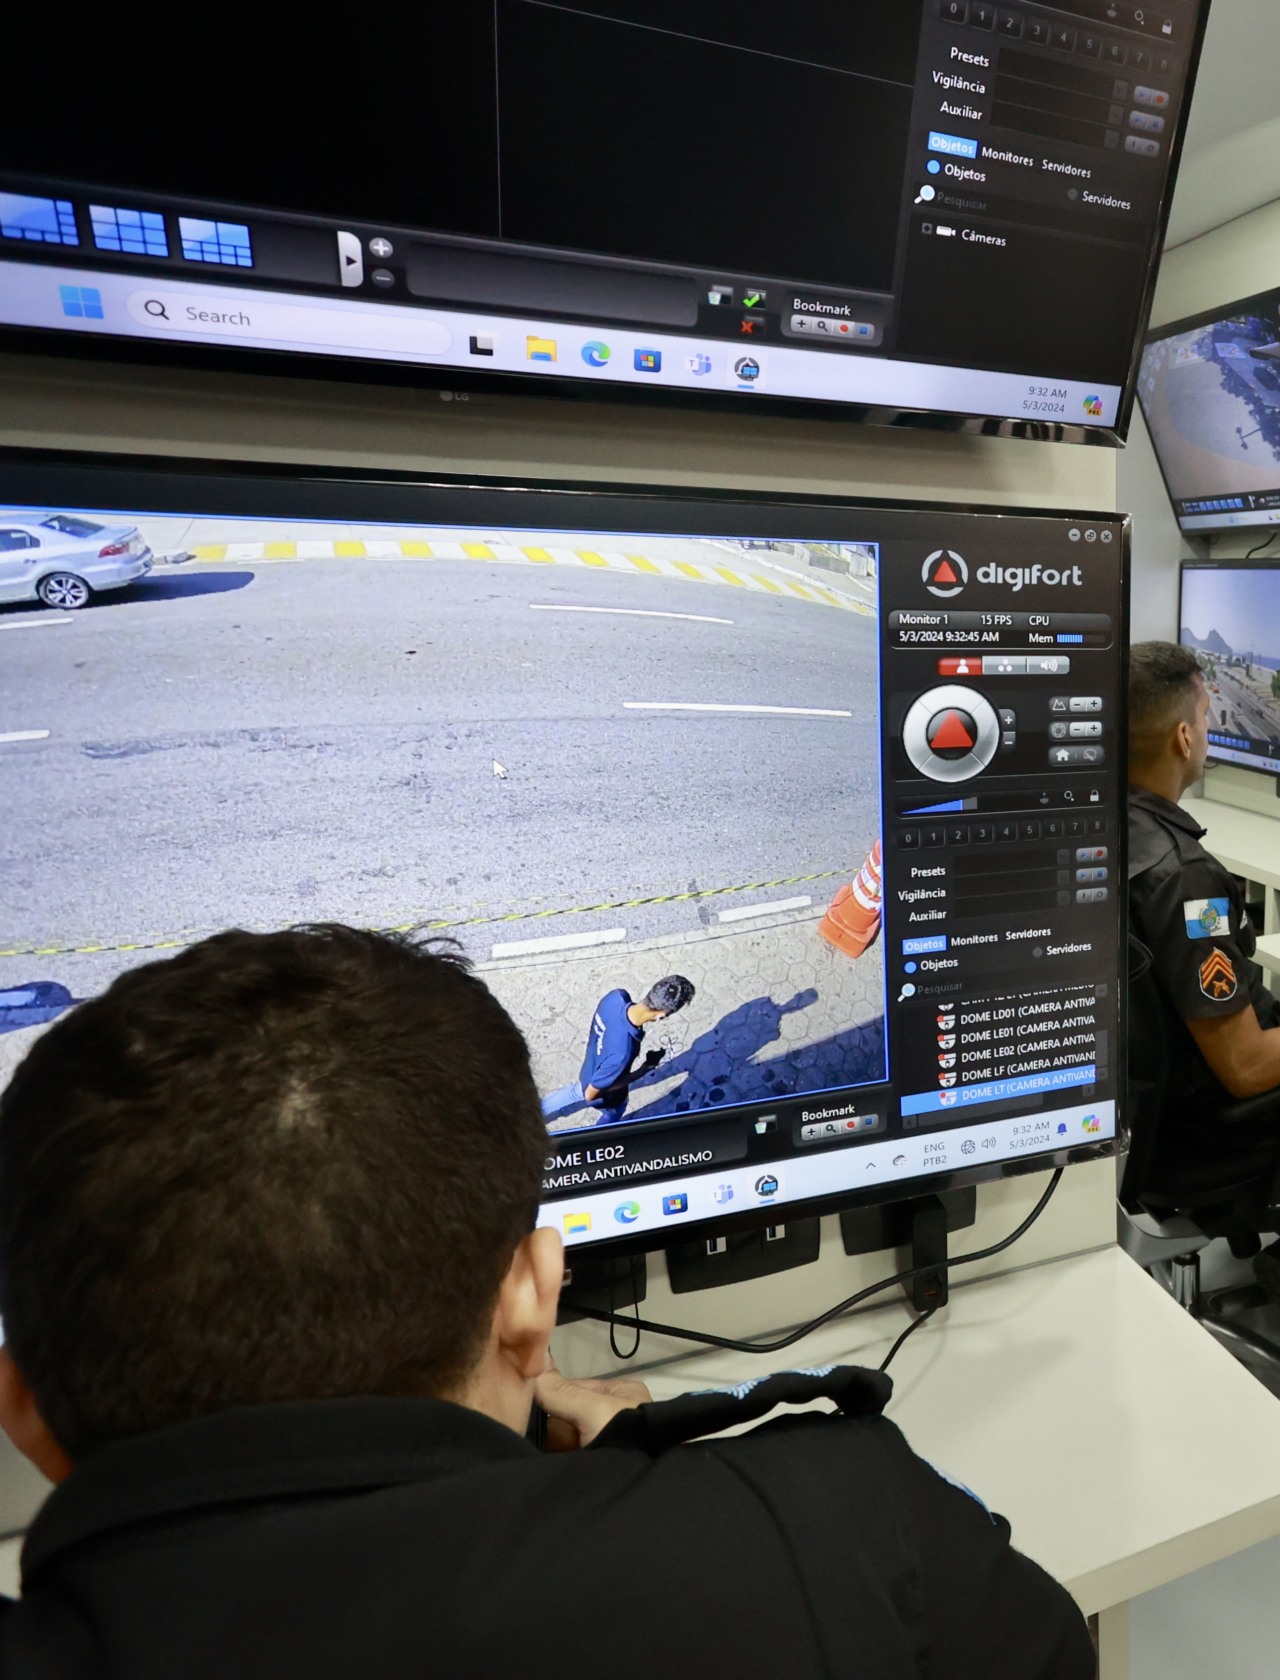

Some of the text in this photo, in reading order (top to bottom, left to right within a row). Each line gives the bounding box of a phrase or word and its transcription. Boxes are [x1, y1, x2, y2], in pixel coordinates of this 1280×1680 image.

[950, 47, 990, 68] Presets
[932, 71, 986, 94] Vigilância
[940, 101, 983, 121] Auxiliar
[931, 136, 1091, 179] Objetos Monitores Servidores
[944, 164, 986, 183] Objetos
[1082, 191, 1131, 210] Servidores
[962, 229, 1006, 247] Câmeras
[793, 298, 851, 316] Bookmark
[186, 306, 251, 327] Search
[455, 392, 469, 401] LG
[1029, 386, 1067, 399] 9:32 AM
[1022, 400, 1065, 413] 5/3/2024
[976, 562, 1082, 592] digifort
[899, 614, 948, 625] Monitor 1
[981, 614, 1012, 625] 15 FPS
[1028, 615, 1049, 626] CPU
[899, 631, 999, 642] 5/3/2024 9:32:45 AM
[1029, 633, 1054, 643] Mem
[911, 867, 946, 878] Presets
[898, 888, 946, 903] Vigilância
[909, 910, 947, 922] Auxiliar
[905, 927, 1051, 952] Objetos Monitores Servidores
[1046, 942, 1092, 956] Servidores
[920, 958, 958, 971] Objetos
[917, 982, 963, 996] Pesquisar
[960, 996, 1095, 1025] DOME LD01 (CAMERA ANTIVA
[961, 1015, 1095, 1044] DOME LE01 (CAMERA ANTIVA
[961, 1033, 1095, 1063] DOME LE02 (CAMERA ANTIVA
[962, 1070, 992, 1082] DOME
[994, 1065, 1005, 1077] LF
[1007, 1060, 1051, 1076] (CAMERA
[962, 1088, 992, 1100] DOME
[994, 1084, 1005, 1095] LT
[1006, 1078, 1051, 1094] (CAMERA
[801, 1105, 855, 1122] Bookmark
[1013, 1122, 1050, 1135] 9:32 AM
[924, 1142, 945, 1154] ENG
[1009, 1135, 1050, 1150] 5/3/2024
[544, 1145, 625, 1171] OME LE02
[923, 1155, 947, 1167] PTB2
[542, 1150, 713, 1189] AMERA ANTIVANDALISMO
